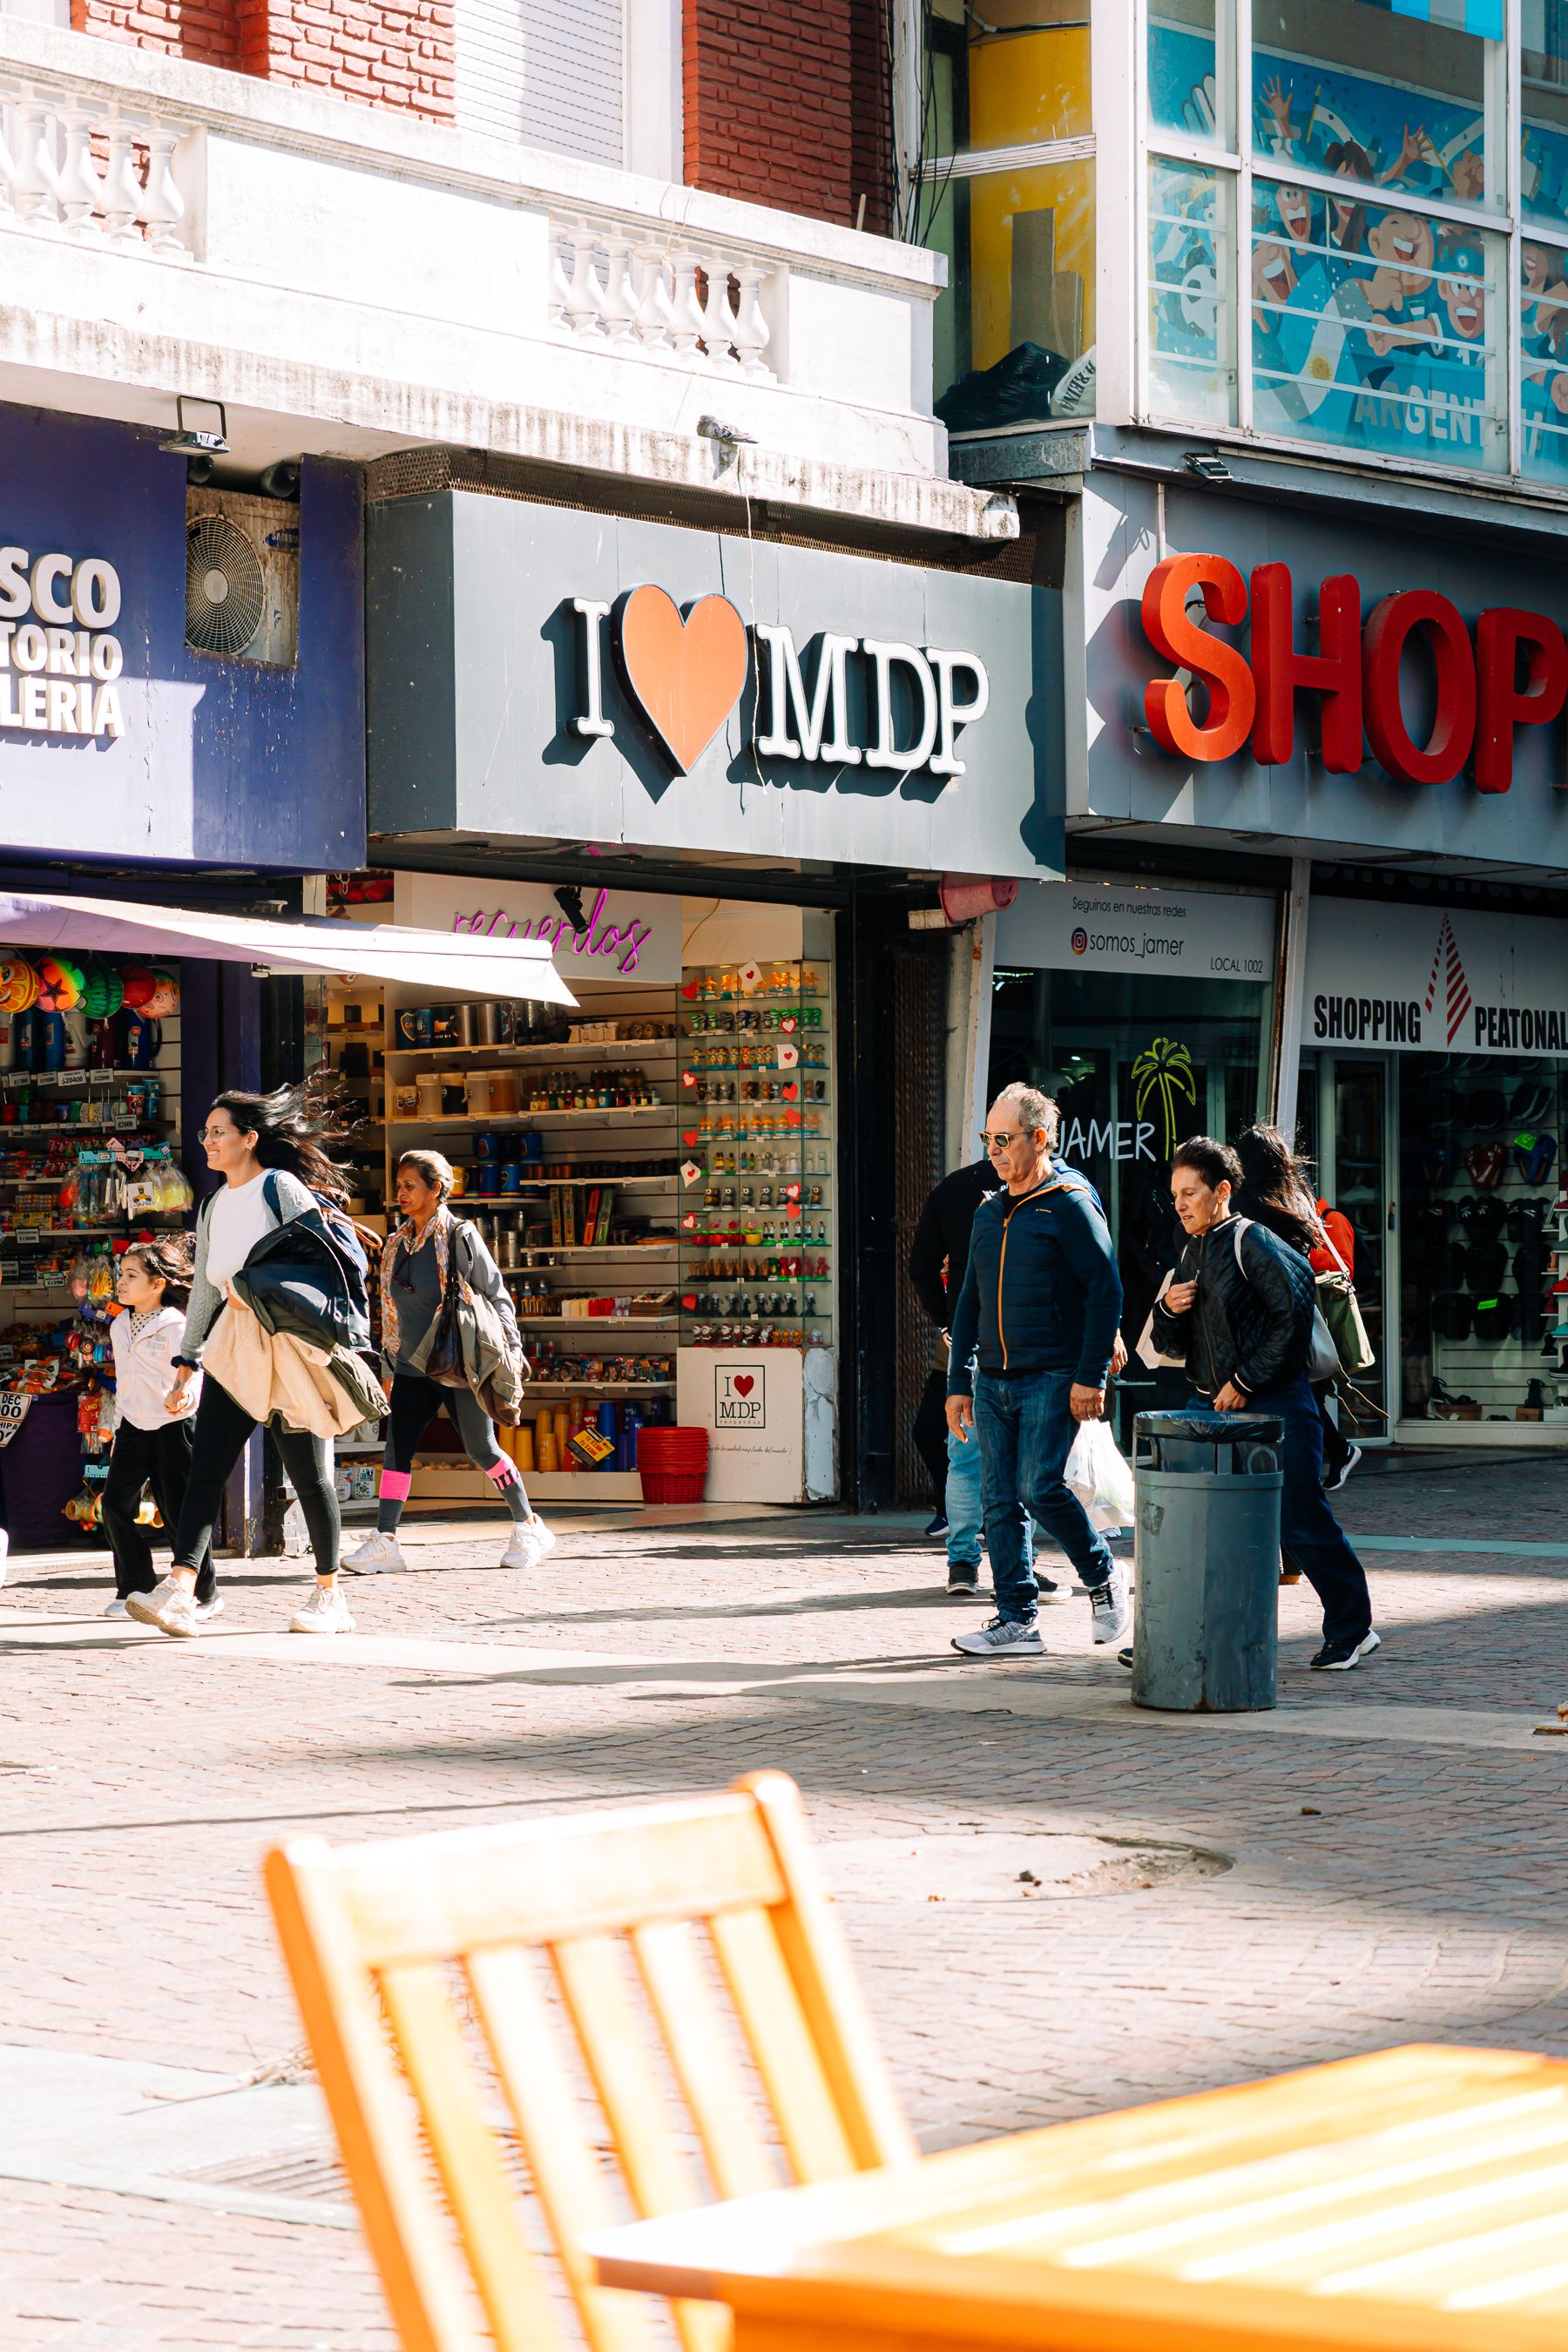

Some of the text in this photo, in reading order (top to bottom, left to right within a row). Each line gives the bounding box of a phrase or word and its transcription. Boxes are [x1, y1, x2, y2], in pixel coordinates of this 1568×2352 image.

[0, 547, 121, 628] SCO
[0, 620, 123, 680] TORIO
[1140, 551, 1568, 794] SHOP
[573, 597, 990, 775] I MDP
[0, 673, 125, 737] LERIA
[1072, 896, 1186, 918] Seguinos en nuestras redes
[1089, 933, 1184, 958] somos_jamer
[1210, 956, 1263, 974] LOCAL 1002
[1314, 995, 1568, 1051] SHOPPING PEATONAL
[61, 1076, 84, 1085] $20400
[1051, 1117, 1157, 1162] JAMER
[724, 1376, 731, 1397] I
[2, 1395, 21, 1405] DEC
[84, 1402, 98, 1411] UNO
[720, 1402, 761, 1419] MDP
